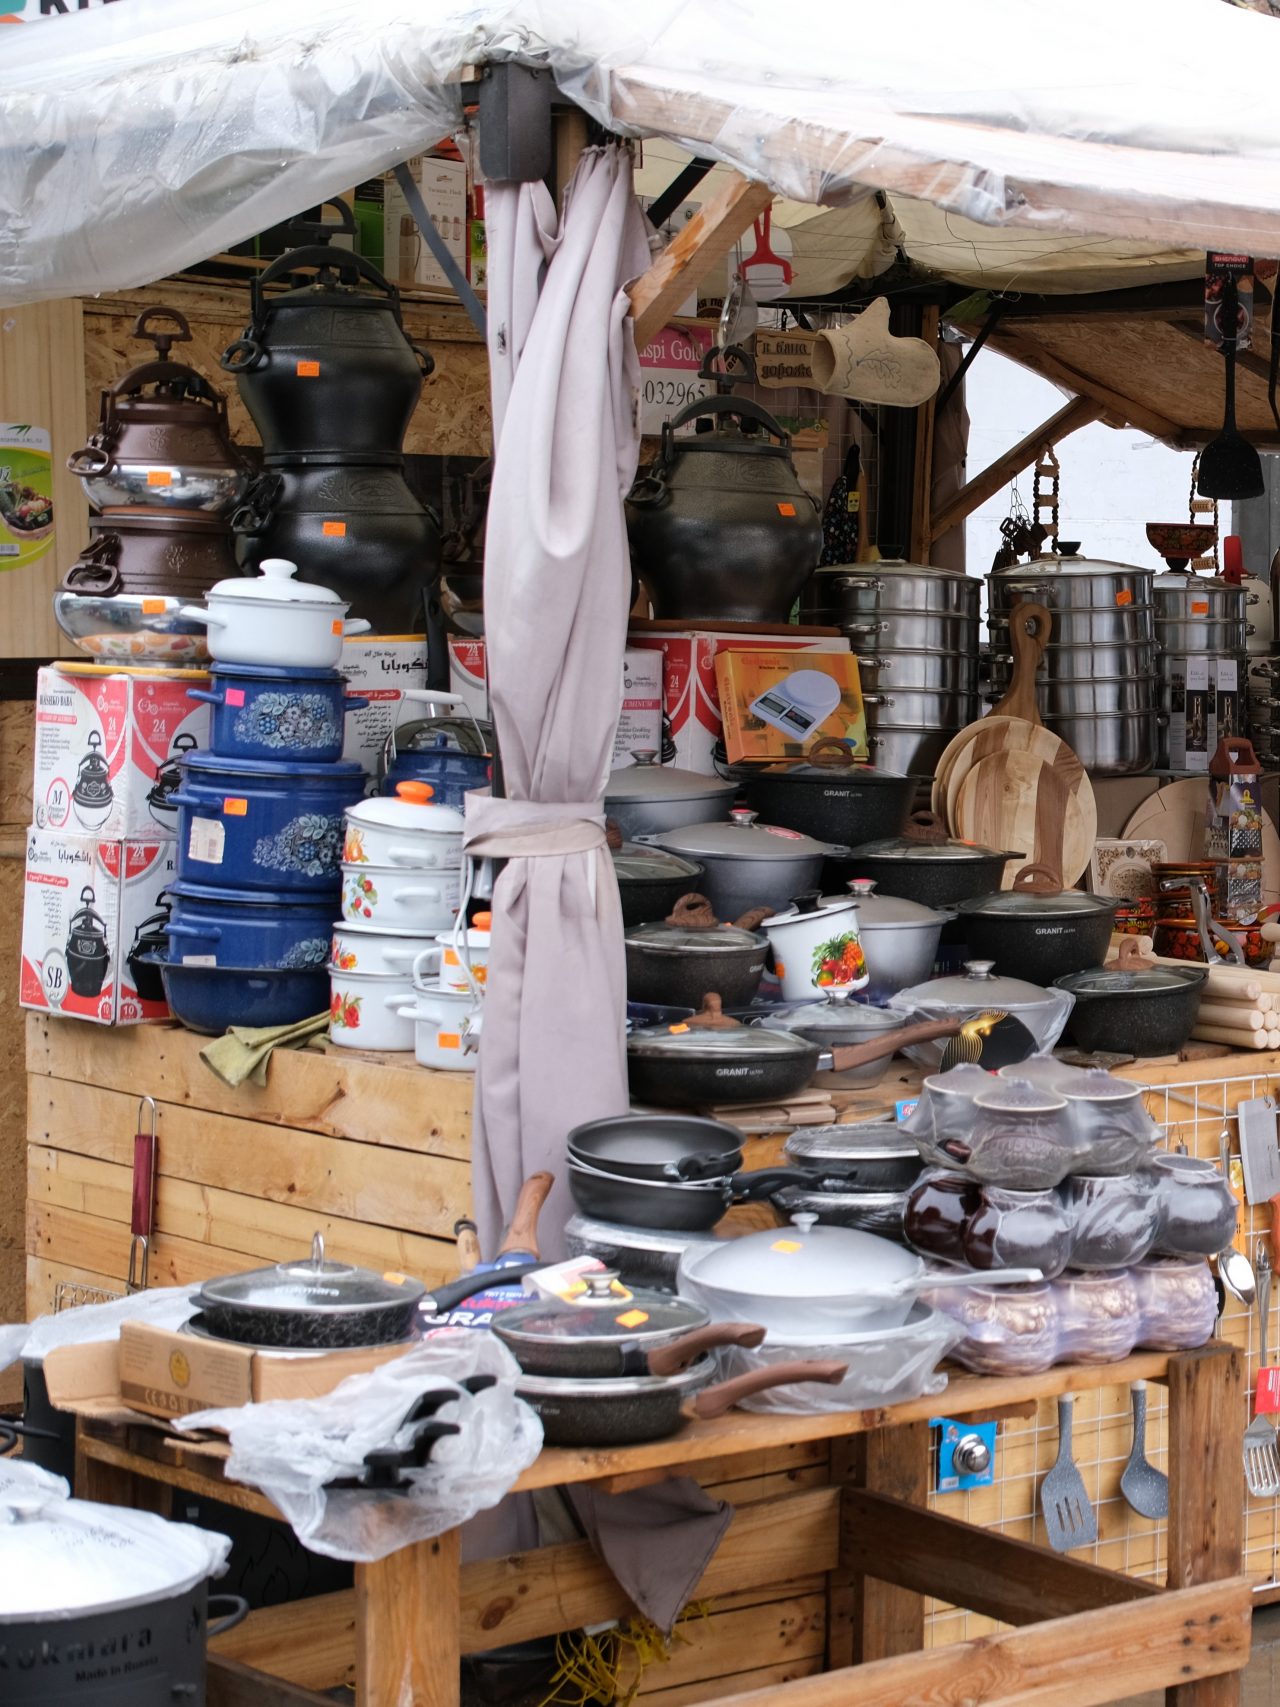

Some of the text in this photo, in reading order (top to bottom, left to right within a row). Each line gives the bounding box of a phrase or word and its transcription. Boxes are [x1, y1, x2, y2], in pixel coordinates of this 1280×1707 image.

[639, 340, 666, 365] aspi
[671, 340, 704, 362] Gold
[642, 380, 706, 406] 032965
[153, 719, 166, 733] 24
[52, 790, 63, 806] M
[824, 790, 850, 798] GRANIT
[1035, 927, 1063, 935] GRANIT
[46, 966, 63, 990] SB
[122, 1006, 135, 1016] 10
[716, 1067, 749, 1077] GRANIT
[75, 1655, 159, 1682] Made in Russia
